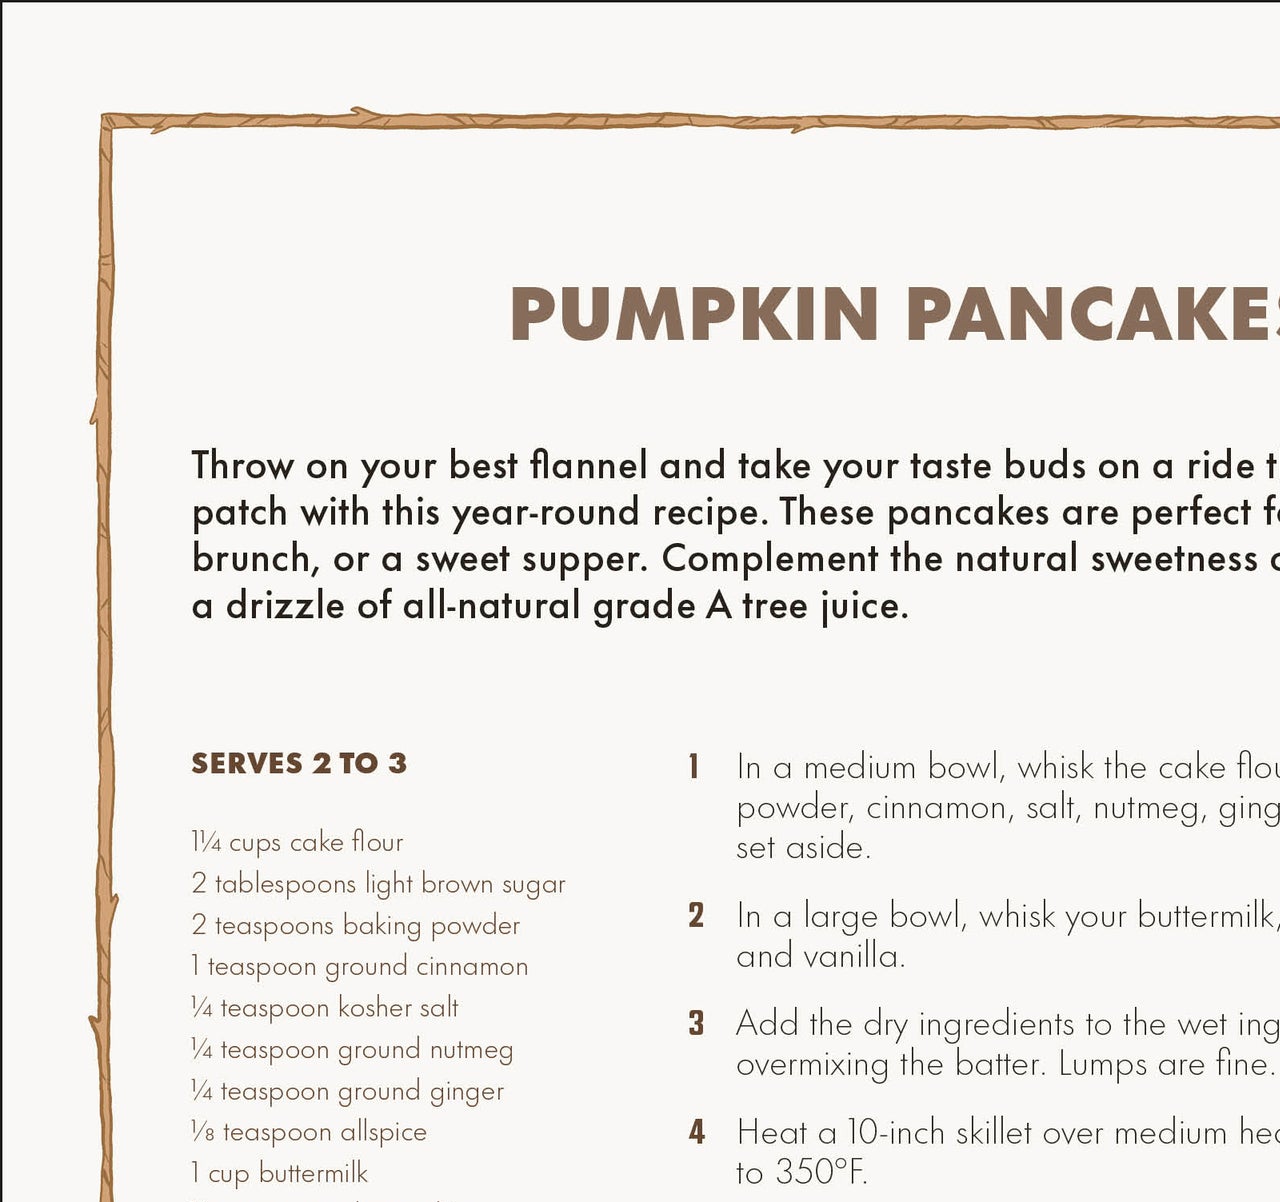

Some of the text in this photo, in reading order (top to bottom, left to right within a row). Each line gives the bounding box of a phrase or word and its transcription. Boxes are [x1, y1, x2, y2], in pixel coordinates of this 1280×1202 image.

[512, 286, 878, 342] PUMPKIN
[190, 447, 296, 481] Throw
[306, 459, 348, 480] on
[360, 459, 438, 489] your
[450, 447, 519, 480] best
[529, 447, 647, 480] flannel
[659, 447, 725, 480] and
[737, 447, 811, 480] take
[822, 458, 900, 489] your
[909, 452, 992, 480] taste
[1005, 446, 1086, 480] buds
[1098, 459, 1140, 480] on
[1152, 459, 1173, 480] a
[1188, 447, 1255, 480] ride
[193, 493, 287, 536] patch
[299, 493, 369, 527] with
[381, 493, 440, 526] this
[451, 493, 639, 536] year-round
[654, 495, 769, 536] recipe.
[778, 493, 874, 526] These
[888, 493, 1050, 536] pancakes
[1062, 505, 1119, 526] are
[1132, 493, 1252, 536] perfect
[191, 751, 408, 775] SERVES 2 TO 3
[688, 752, 698, 779] 1
[739, 751, 760, 780] In
[773, 762, 792, 779] a
[805, 749, 915, 780] medium
[929, 749, 1005, 784] bowl,
[1017, 749, 1095, 780] whisk
[1103, 749, 1147, 780] the
[1159, 749, 1226, 779] cake
[738, 789, 854, 828] powder,
[867, 795, 1014, 824] cinnamon,
[1026, 789, 1081, 824] salt,
[1094, 796, 1207, 828] nutmeg,
[229, 838, 281, 860] cups
[290, 827, 344, 852] cake
[351, 827, 404, 852] flour
[192, 869, 566, 901] 2 tablespoons light brown sugar
[192, 911, 521, 943] 2 teaspoons baking powder
[191, 951, 528, 983] 1 teaspoon ground cinnamon
[220, 999, 329, 1025] teaspoon
[339, 993, 413, 1018] kosher
[419, 993, 459, 1018] salt
[688, 1009, 704, 1036] 3
[735, 1006, 798, 1036] Add
[809, 1006, 853, 1036] the
[863, 1006, 909, 1045] dry
[920, 1006, 1075, 1045] ingredients
[1085, 1013, 1112, 1036] to
[1123, 1006, 1166, 1036] the
[1177, 1013, 1228, 1036] wet
[736, 1045, 1275, 1085] overmixing the batter. Lumps are fine.
[223, 1122, 331, 1149] teaspoon
[340, 1117, 427, 1149] allspice
[191, 1158, 368, 1191] 1 cup buttermilk
[735, 1162, 764, 1185] to
